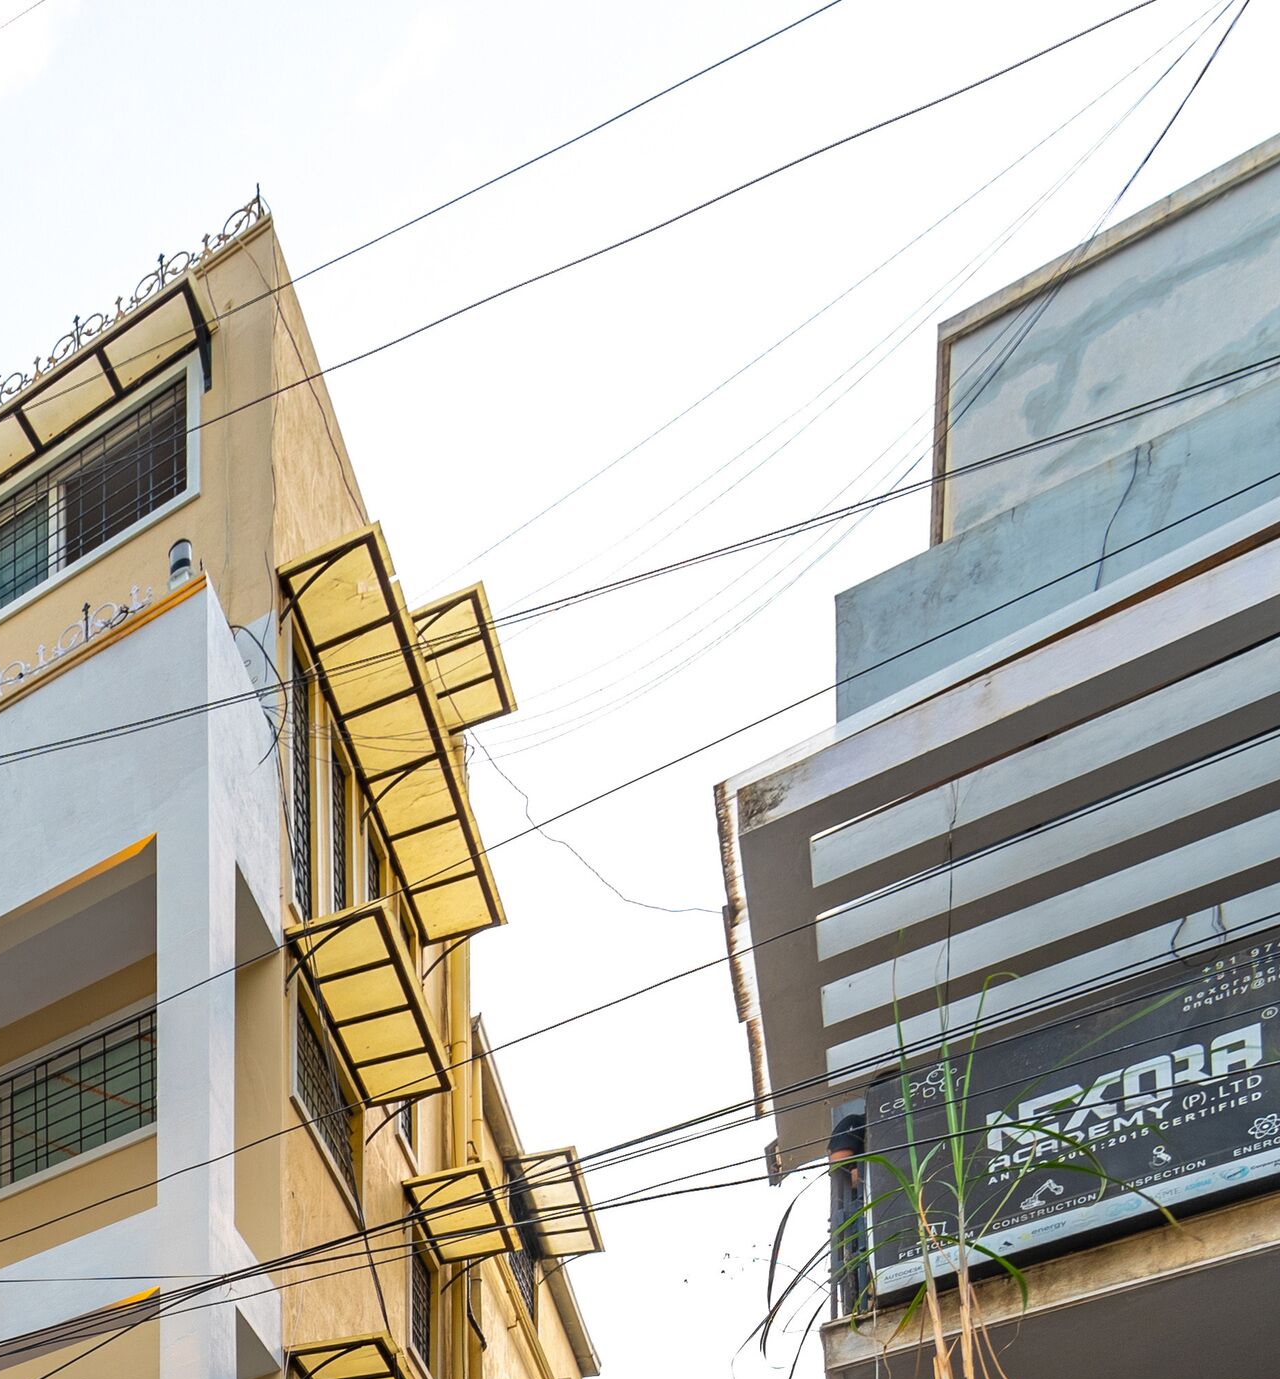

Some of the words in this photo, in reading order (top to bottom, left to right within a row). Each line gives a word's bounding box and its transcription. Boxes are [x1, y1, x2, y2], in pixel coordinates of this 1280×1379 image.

[1182, 974, 1280, 1013] enquiry@n
[1184, 965, 1280, 1004] nexoraac
[986, 1022, 1264, 1152] NEXORA
[987, 1101, 1172, 1174] ACADEMY
[1182, 1074, 1263, 1111] (P).LTD
[988, 1171, 1011, 1186] AN
[1158, 1092, 1264, 1131] CERTIFIED
[1120, 1159, 1207, 1192] INSPECTION
[991, 1192, 1098, 1231] CONSTRUCTION
[1031, 1219, 1068, 1237] energy
[898, 1230, 975, 1261] PETROLM
